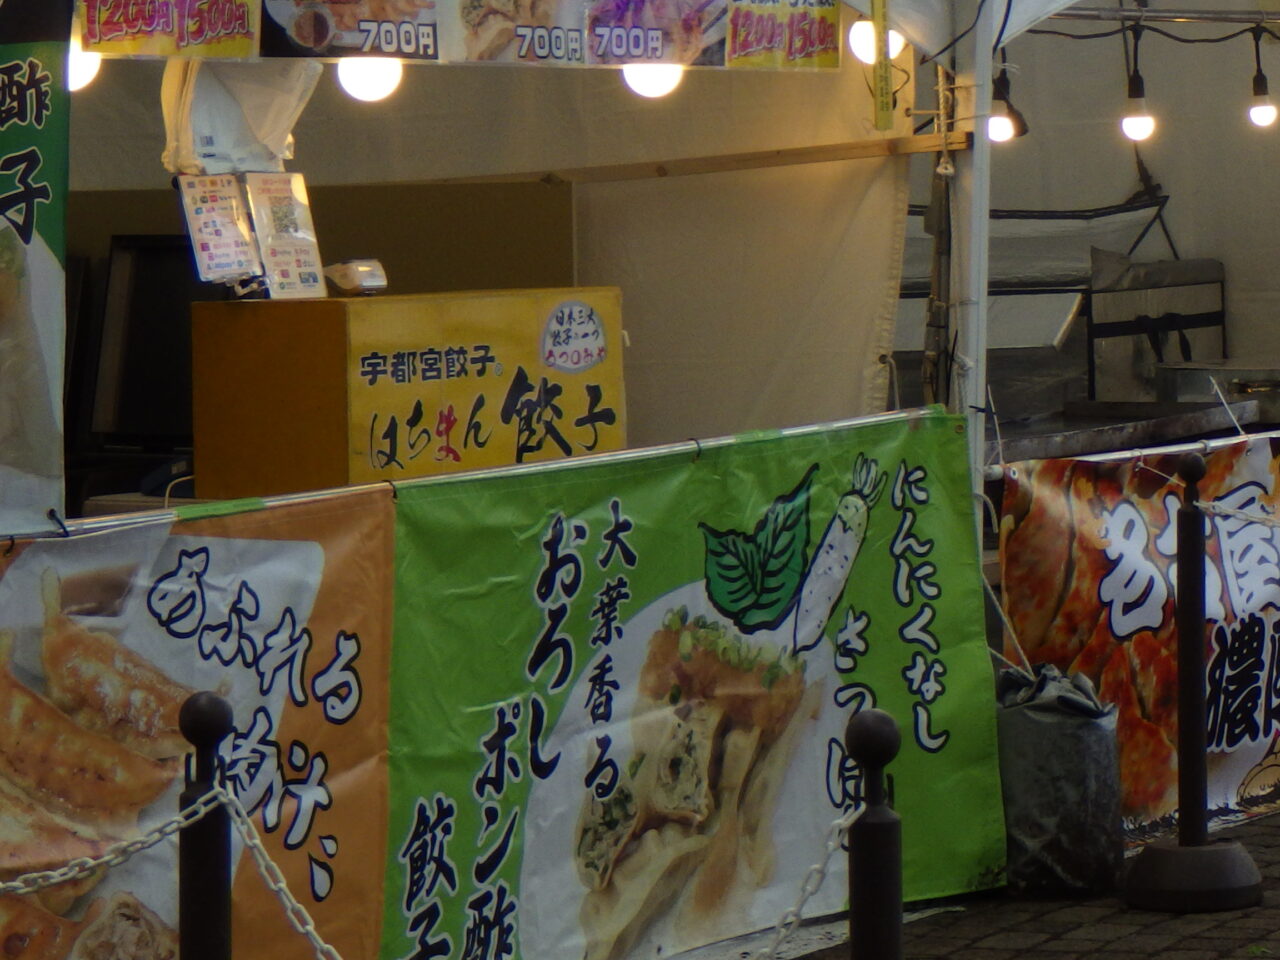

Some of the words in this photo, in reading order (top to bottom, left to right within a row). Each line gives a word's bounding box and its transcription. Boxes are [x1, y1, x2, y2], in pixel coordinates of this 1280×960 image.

[358, 19, 436, 56] 700円
[515, 25, 583, 61] 700円
[594, 25, 664, 59] 700円
[360, 344, 496, 386] 宇都宮餃子
[369, 366, 617, 470] はちまん餃子
[890, 458, 951, 754] にんにくなし
[585, 499, 638, 802] 大葉香る
